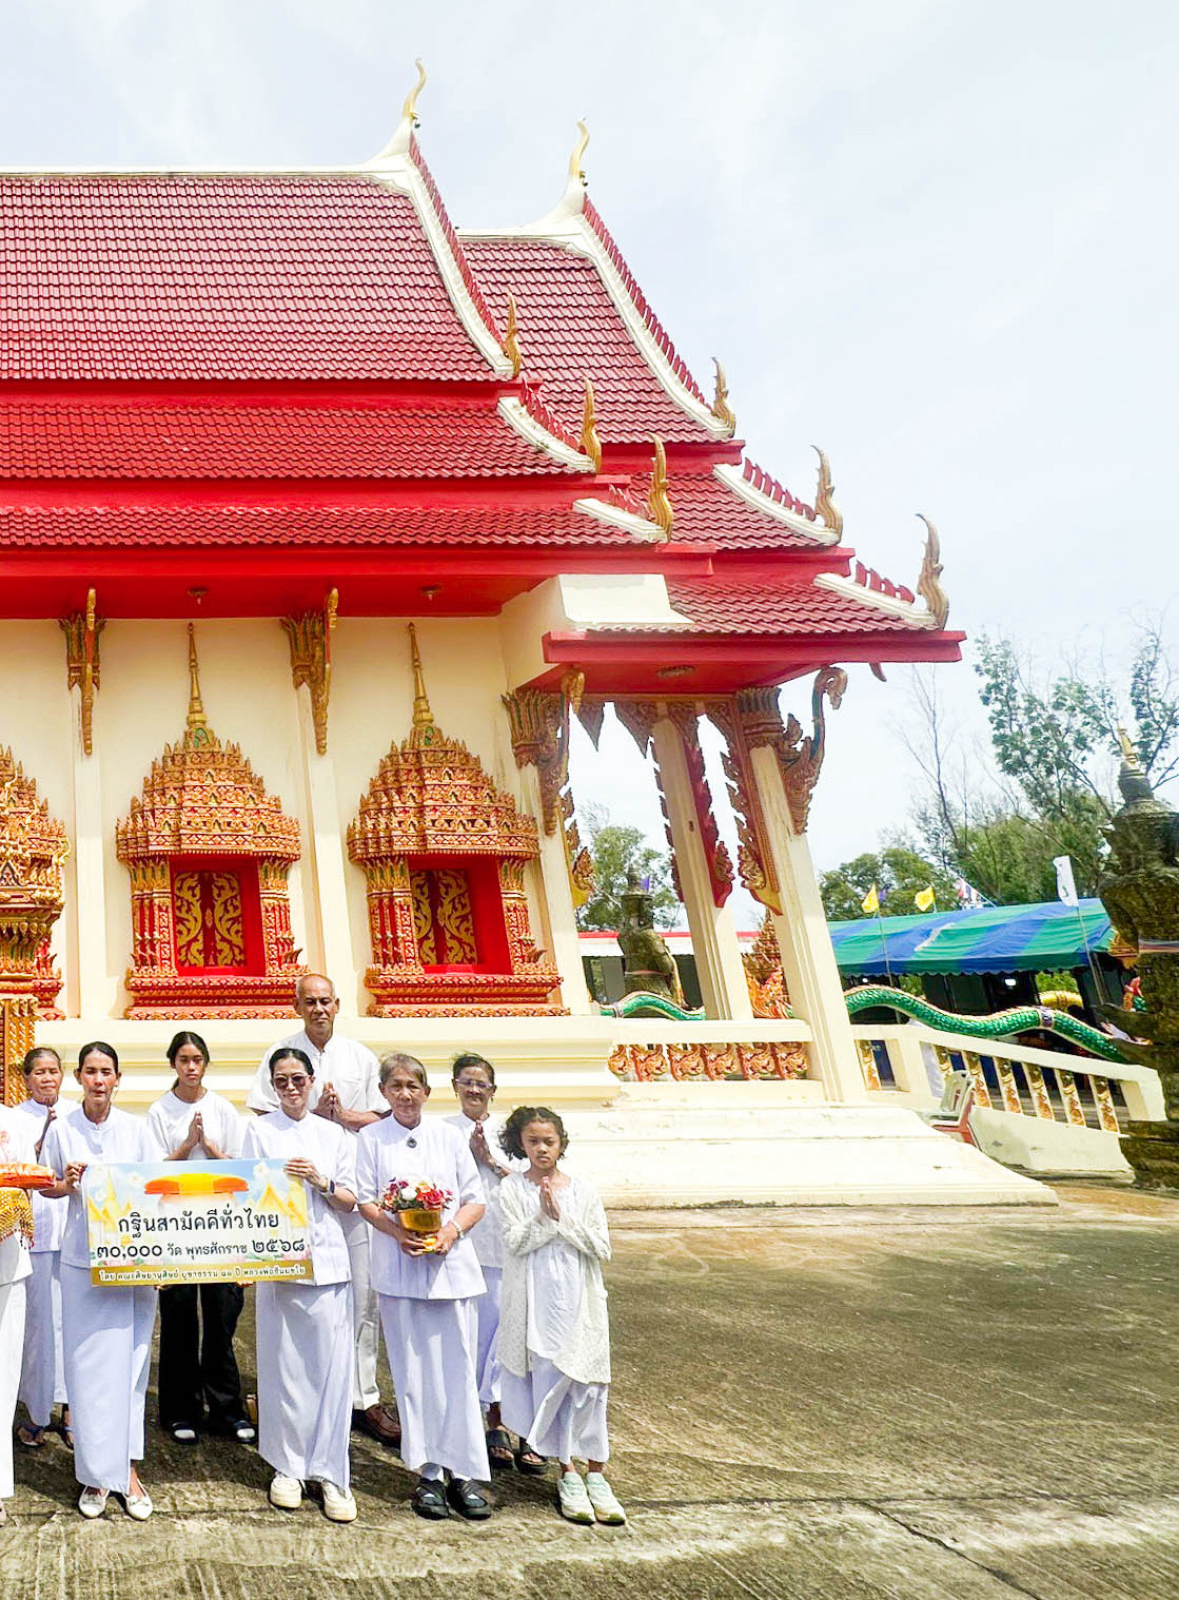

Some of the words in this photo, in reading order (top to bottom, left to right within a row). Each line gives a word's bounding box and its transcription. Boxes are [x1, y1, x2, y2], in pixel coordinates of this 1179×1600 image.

[118, 1203, 280, 1239] กฐินสามัคคีทั่วไทย
[96, 1244, 163, 1260] ๓๐,๐๐๐
[167, 1243, 183, 1257] วัด
[185, 1241, 248, 1261] พุทธศักราช
[252, 1238, 306, 1253] ๒๕๖๘
